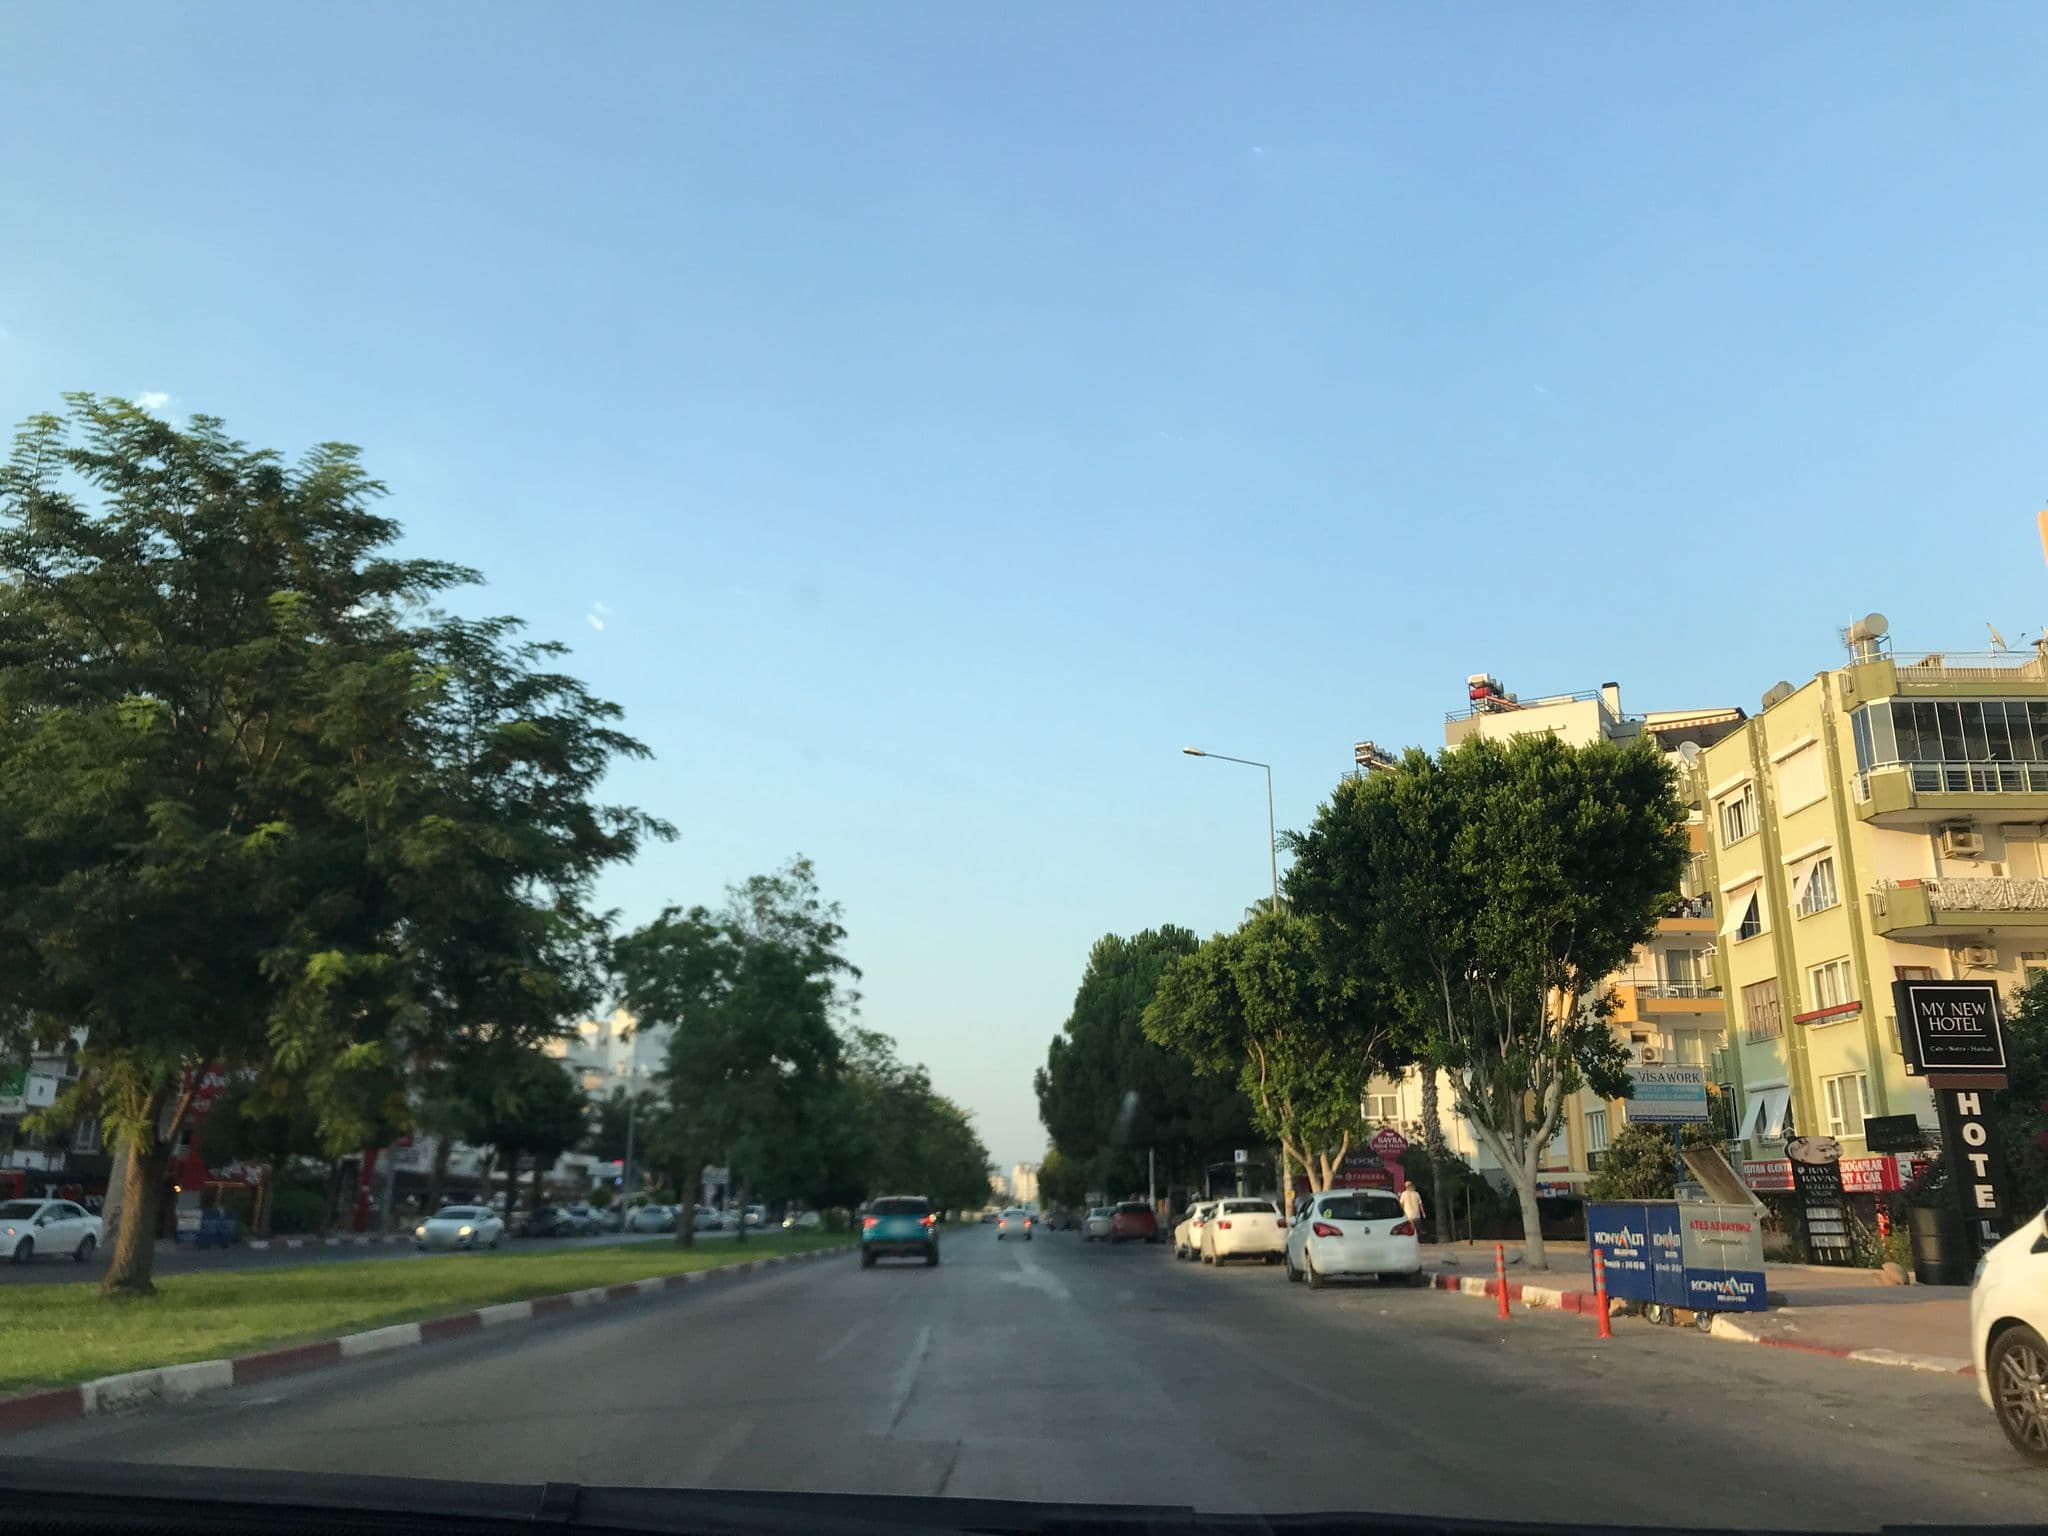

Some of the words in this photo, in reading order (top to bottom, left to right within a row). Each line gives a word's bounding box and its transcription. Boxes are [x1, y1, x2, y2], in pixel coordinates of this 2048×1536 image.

[1921, 1002, 1945, 1016] MY
[1951, 1002, 1986, 1016] NEW
[1929, 1017, 1983, 1031] HOTEL
[1667, 1072, 1701, 1083] WORK
[1956, 1092, 2000, 1240] HOTEL
[1855, 1172, 1862, 1184] A
[1863, 1171, 1882, 1183] CAR
